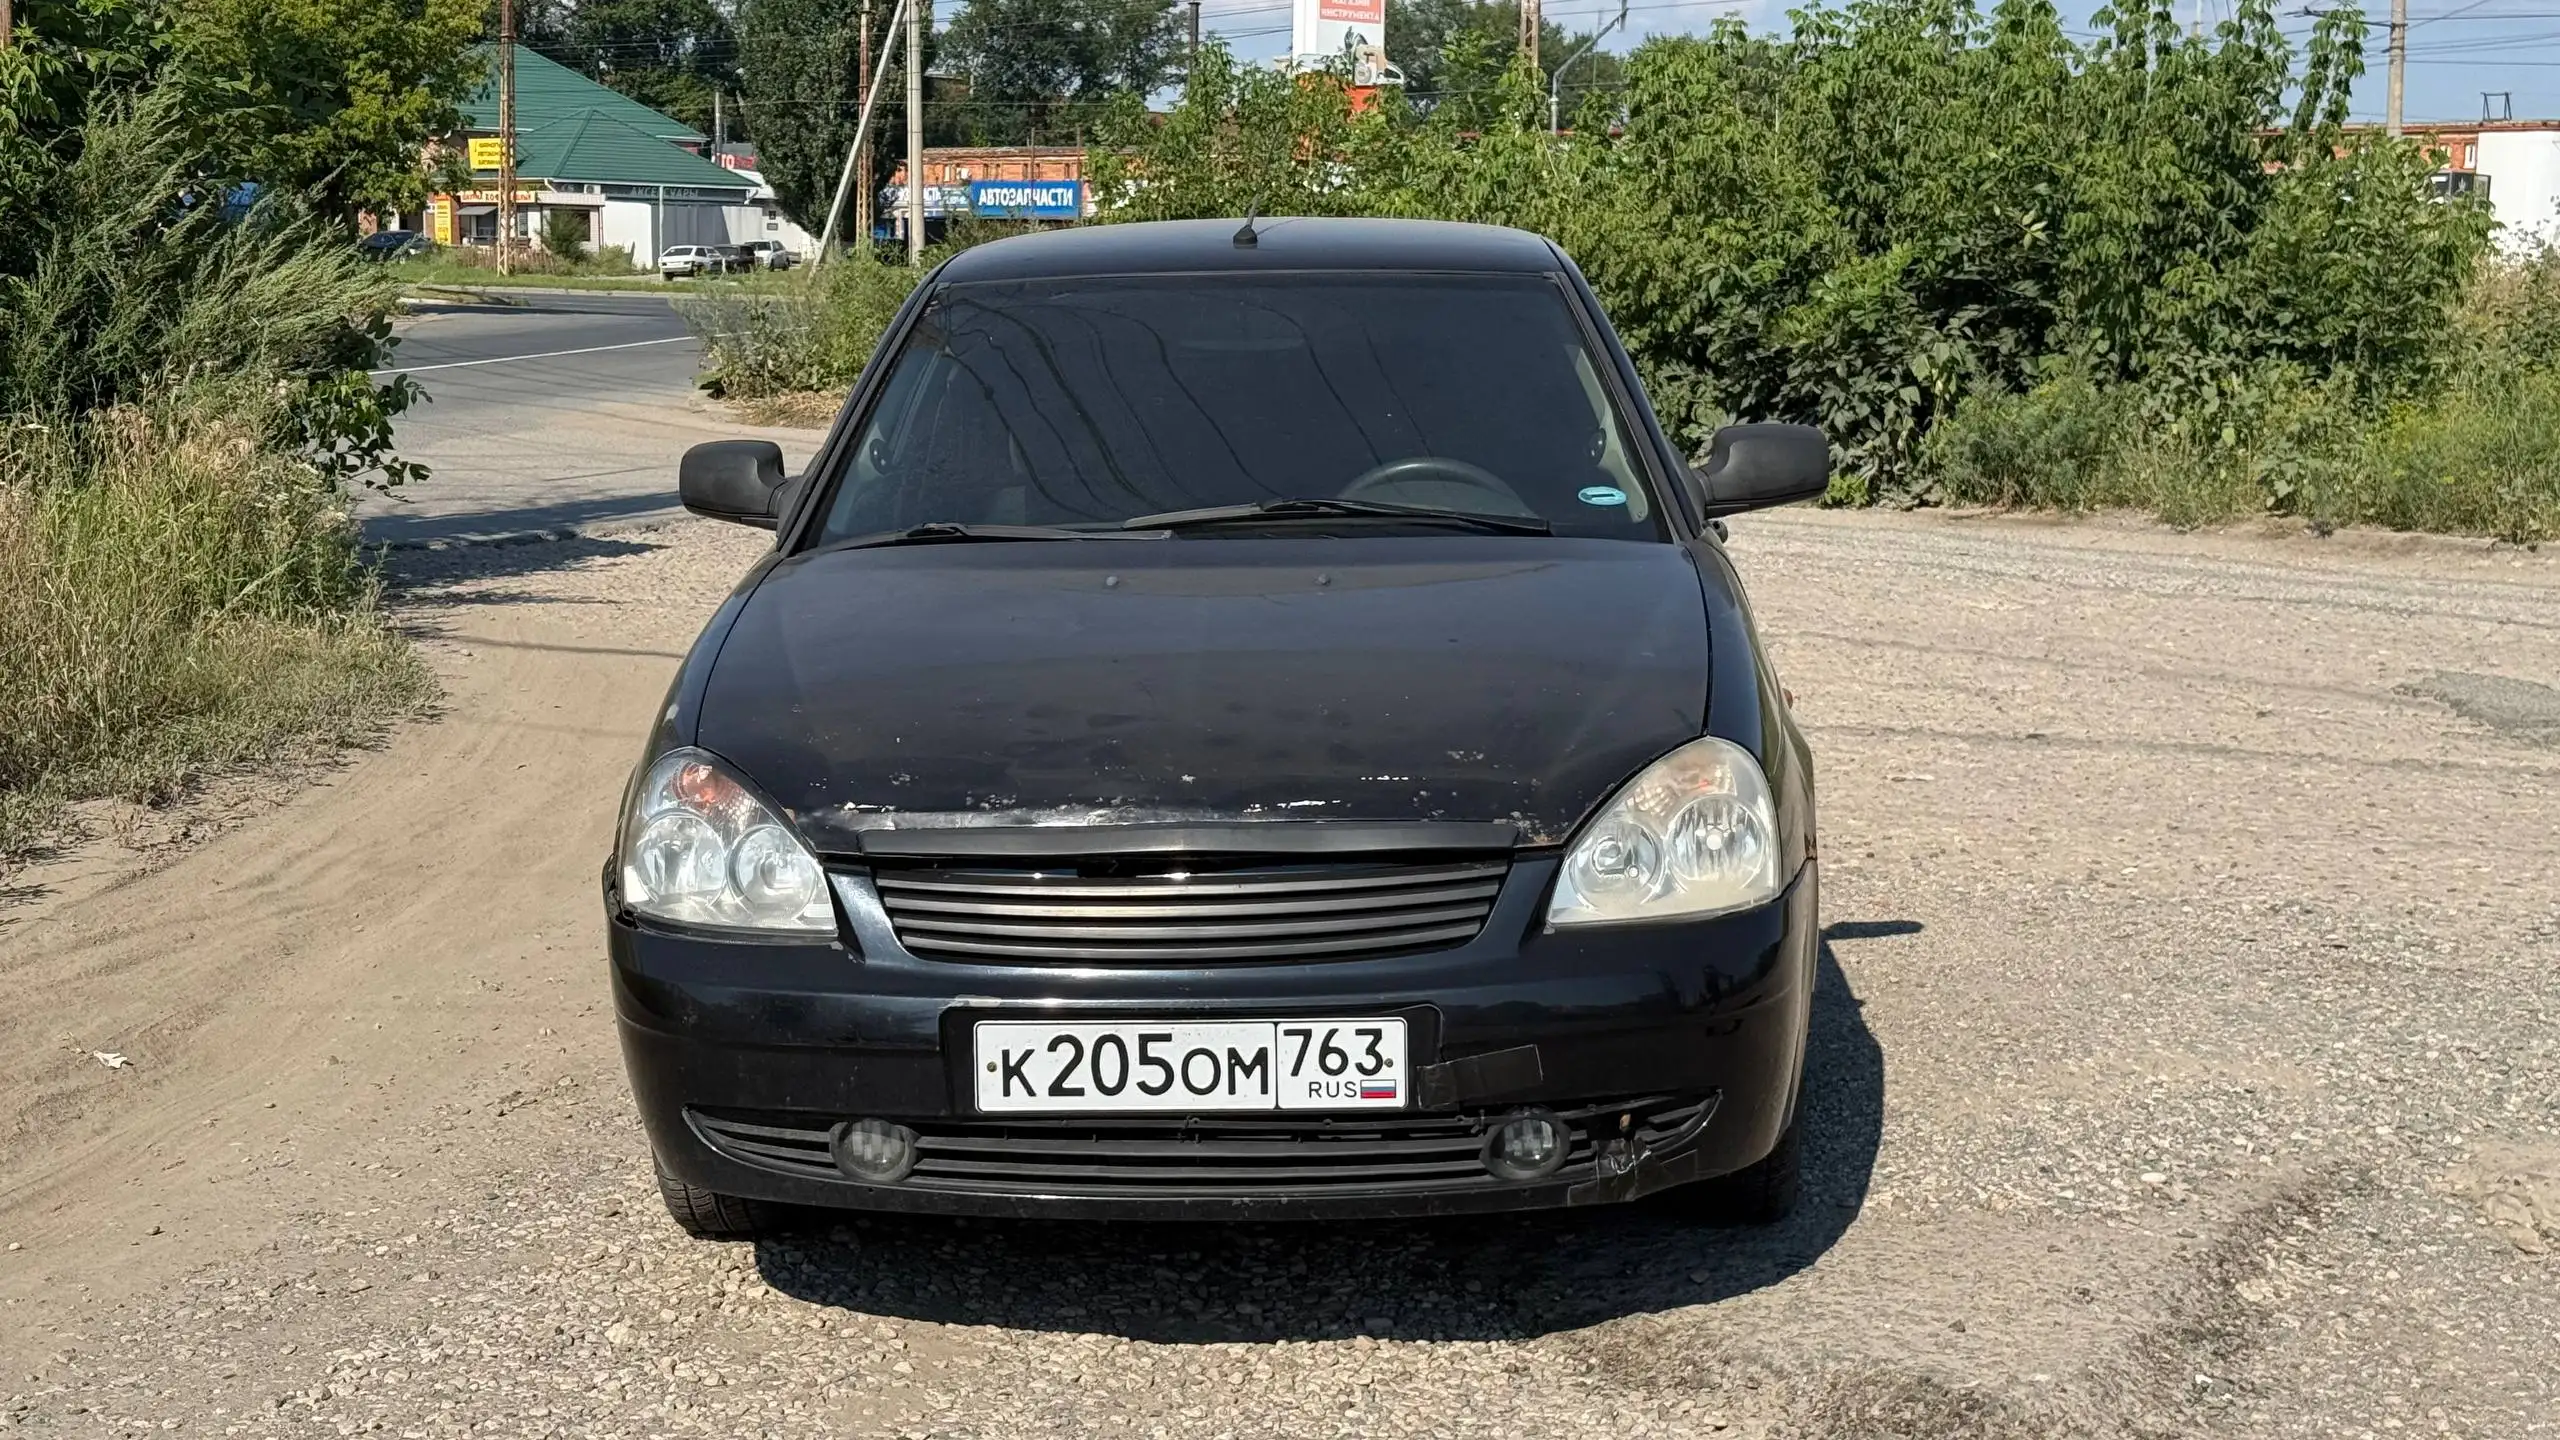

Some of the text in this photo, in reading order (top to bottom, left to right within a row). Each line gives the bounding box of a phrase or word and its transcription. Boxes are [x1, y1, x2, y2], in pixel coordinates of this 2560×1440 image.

[630, 186, 699, 199] АКСЕСУАРЫ
[978, 187, 1073, 207] АВТОЗАПЧАСТИ
[1001, 1028, 1384, 1097] К205ОМ 763
[1309, 1081, 1357, 1098] RUS
